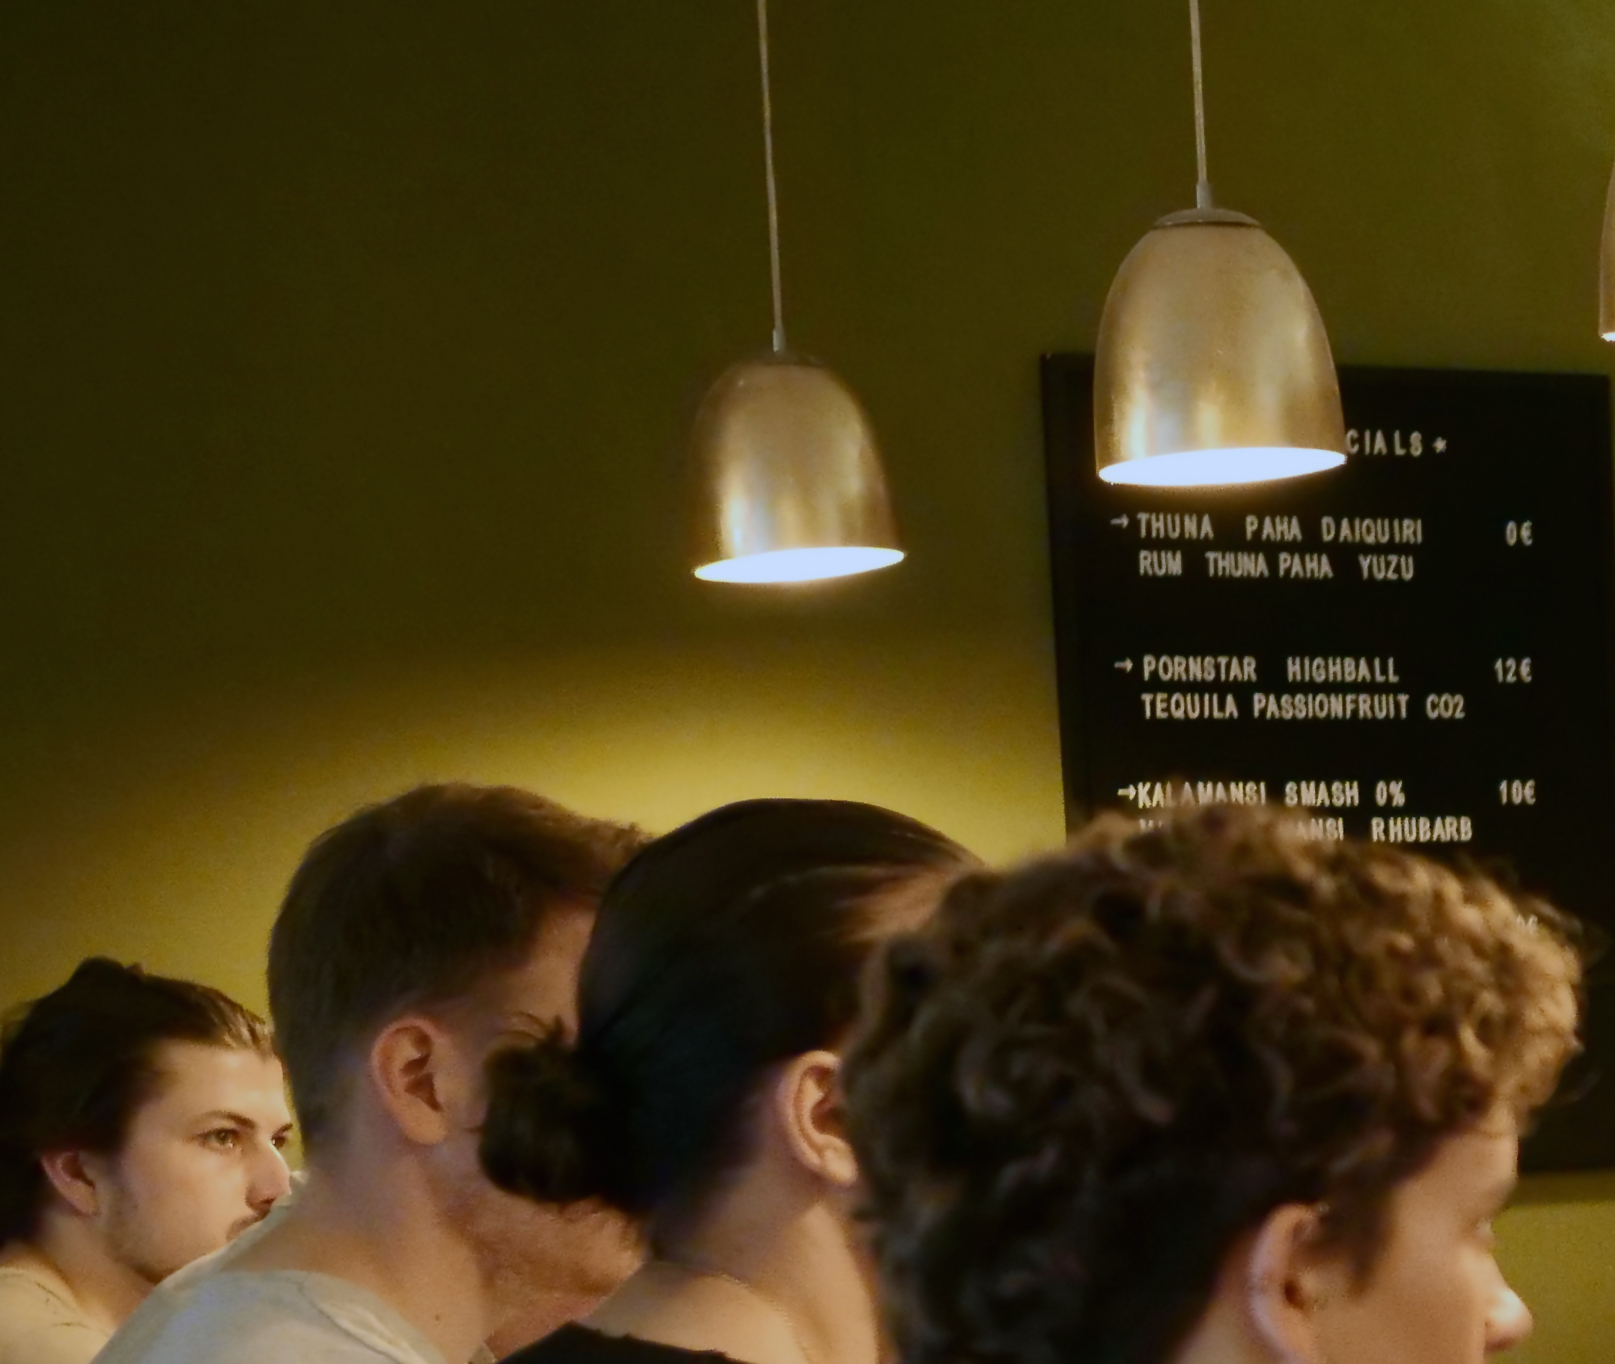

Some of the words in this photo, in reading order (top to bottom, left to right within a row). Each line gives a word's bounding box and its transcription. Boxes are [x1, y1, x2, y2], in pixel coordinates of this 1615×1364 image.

[1137, 512, 1214, 539] THUNA
[1246, 515, 1302, 541] PAHA
[1321, 517, 1422, 544] DAIQUIRI
[1506, 520, 1533, 546] 0€
[1140, 550, 1182, 575] RUM
[1205, 552, 1268, 577] THUNA
[1279, 552, 1333, 578] PAHA
[1359, 554, 1414, 580] YUZU
[1143, 655, 1257, 681] PORNSTAR
[1287, 656, 1400, 682] HIGHBALL
[1494, 657, 1532, 683] 12€
[1141, 693, 1238, 719] TEQUILA
[1253, 693, 1409, 719] PASSIONFRUIT
[1426, 693, 1466, 719] CO2
[1284, 781, 1359, 808] SMASH
[1375, 781, 1406, 808] 0%
[1500, 779, 1536, 805] 10€
[1370, 816, 1473, 843] RHUBARB
